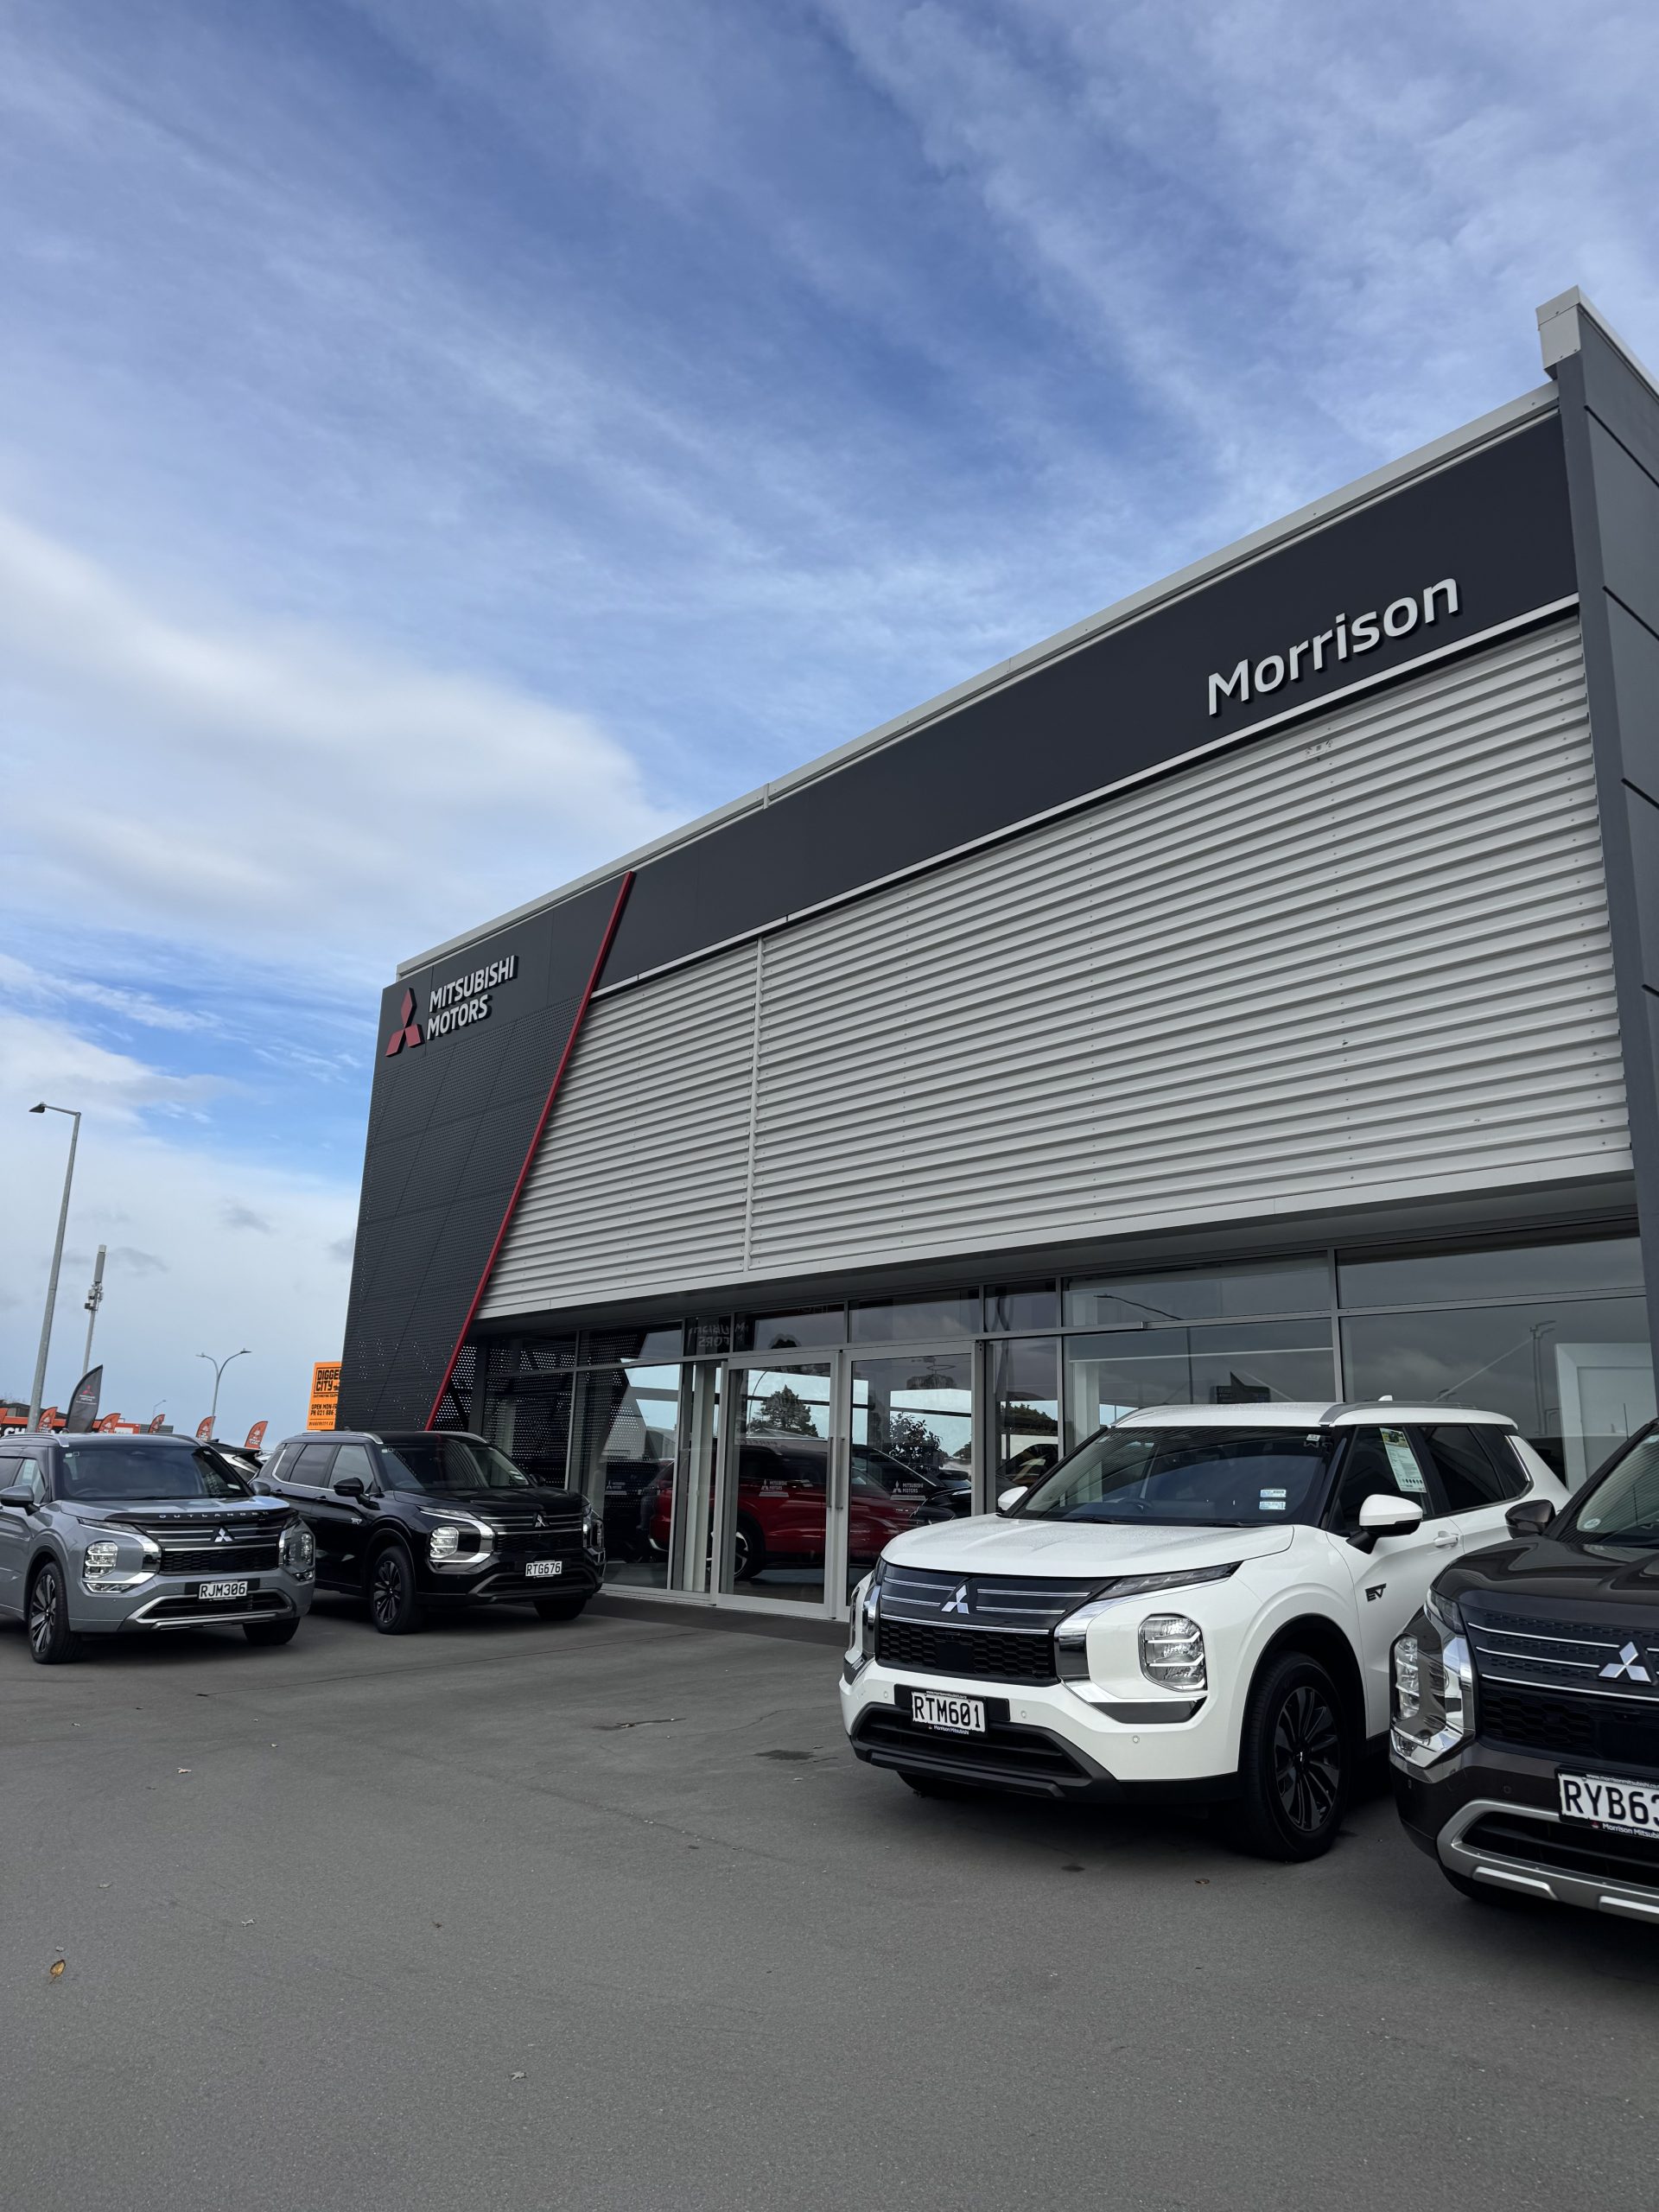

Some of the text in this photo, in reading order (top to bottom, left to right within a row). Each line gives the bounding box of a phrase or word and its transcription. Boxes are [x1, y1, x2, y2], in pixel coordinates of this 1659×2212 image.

[1208, 577, 1459, 716] Morrison
[429, 955, 514, 1013] MITSUBISHI
[426, 995, 490, 1041] MOTORS
[317, 1370, 340, 1380] DIGGE
[316, 1381, 333, 1391] CITY
[527, 1562, 560, 1574] RTG676
[200, 1582, 246, 1598] RJM306
[914, 1695, 980, 1728] RTM601
[1602, 1823, 1633, 1834] Morrison
